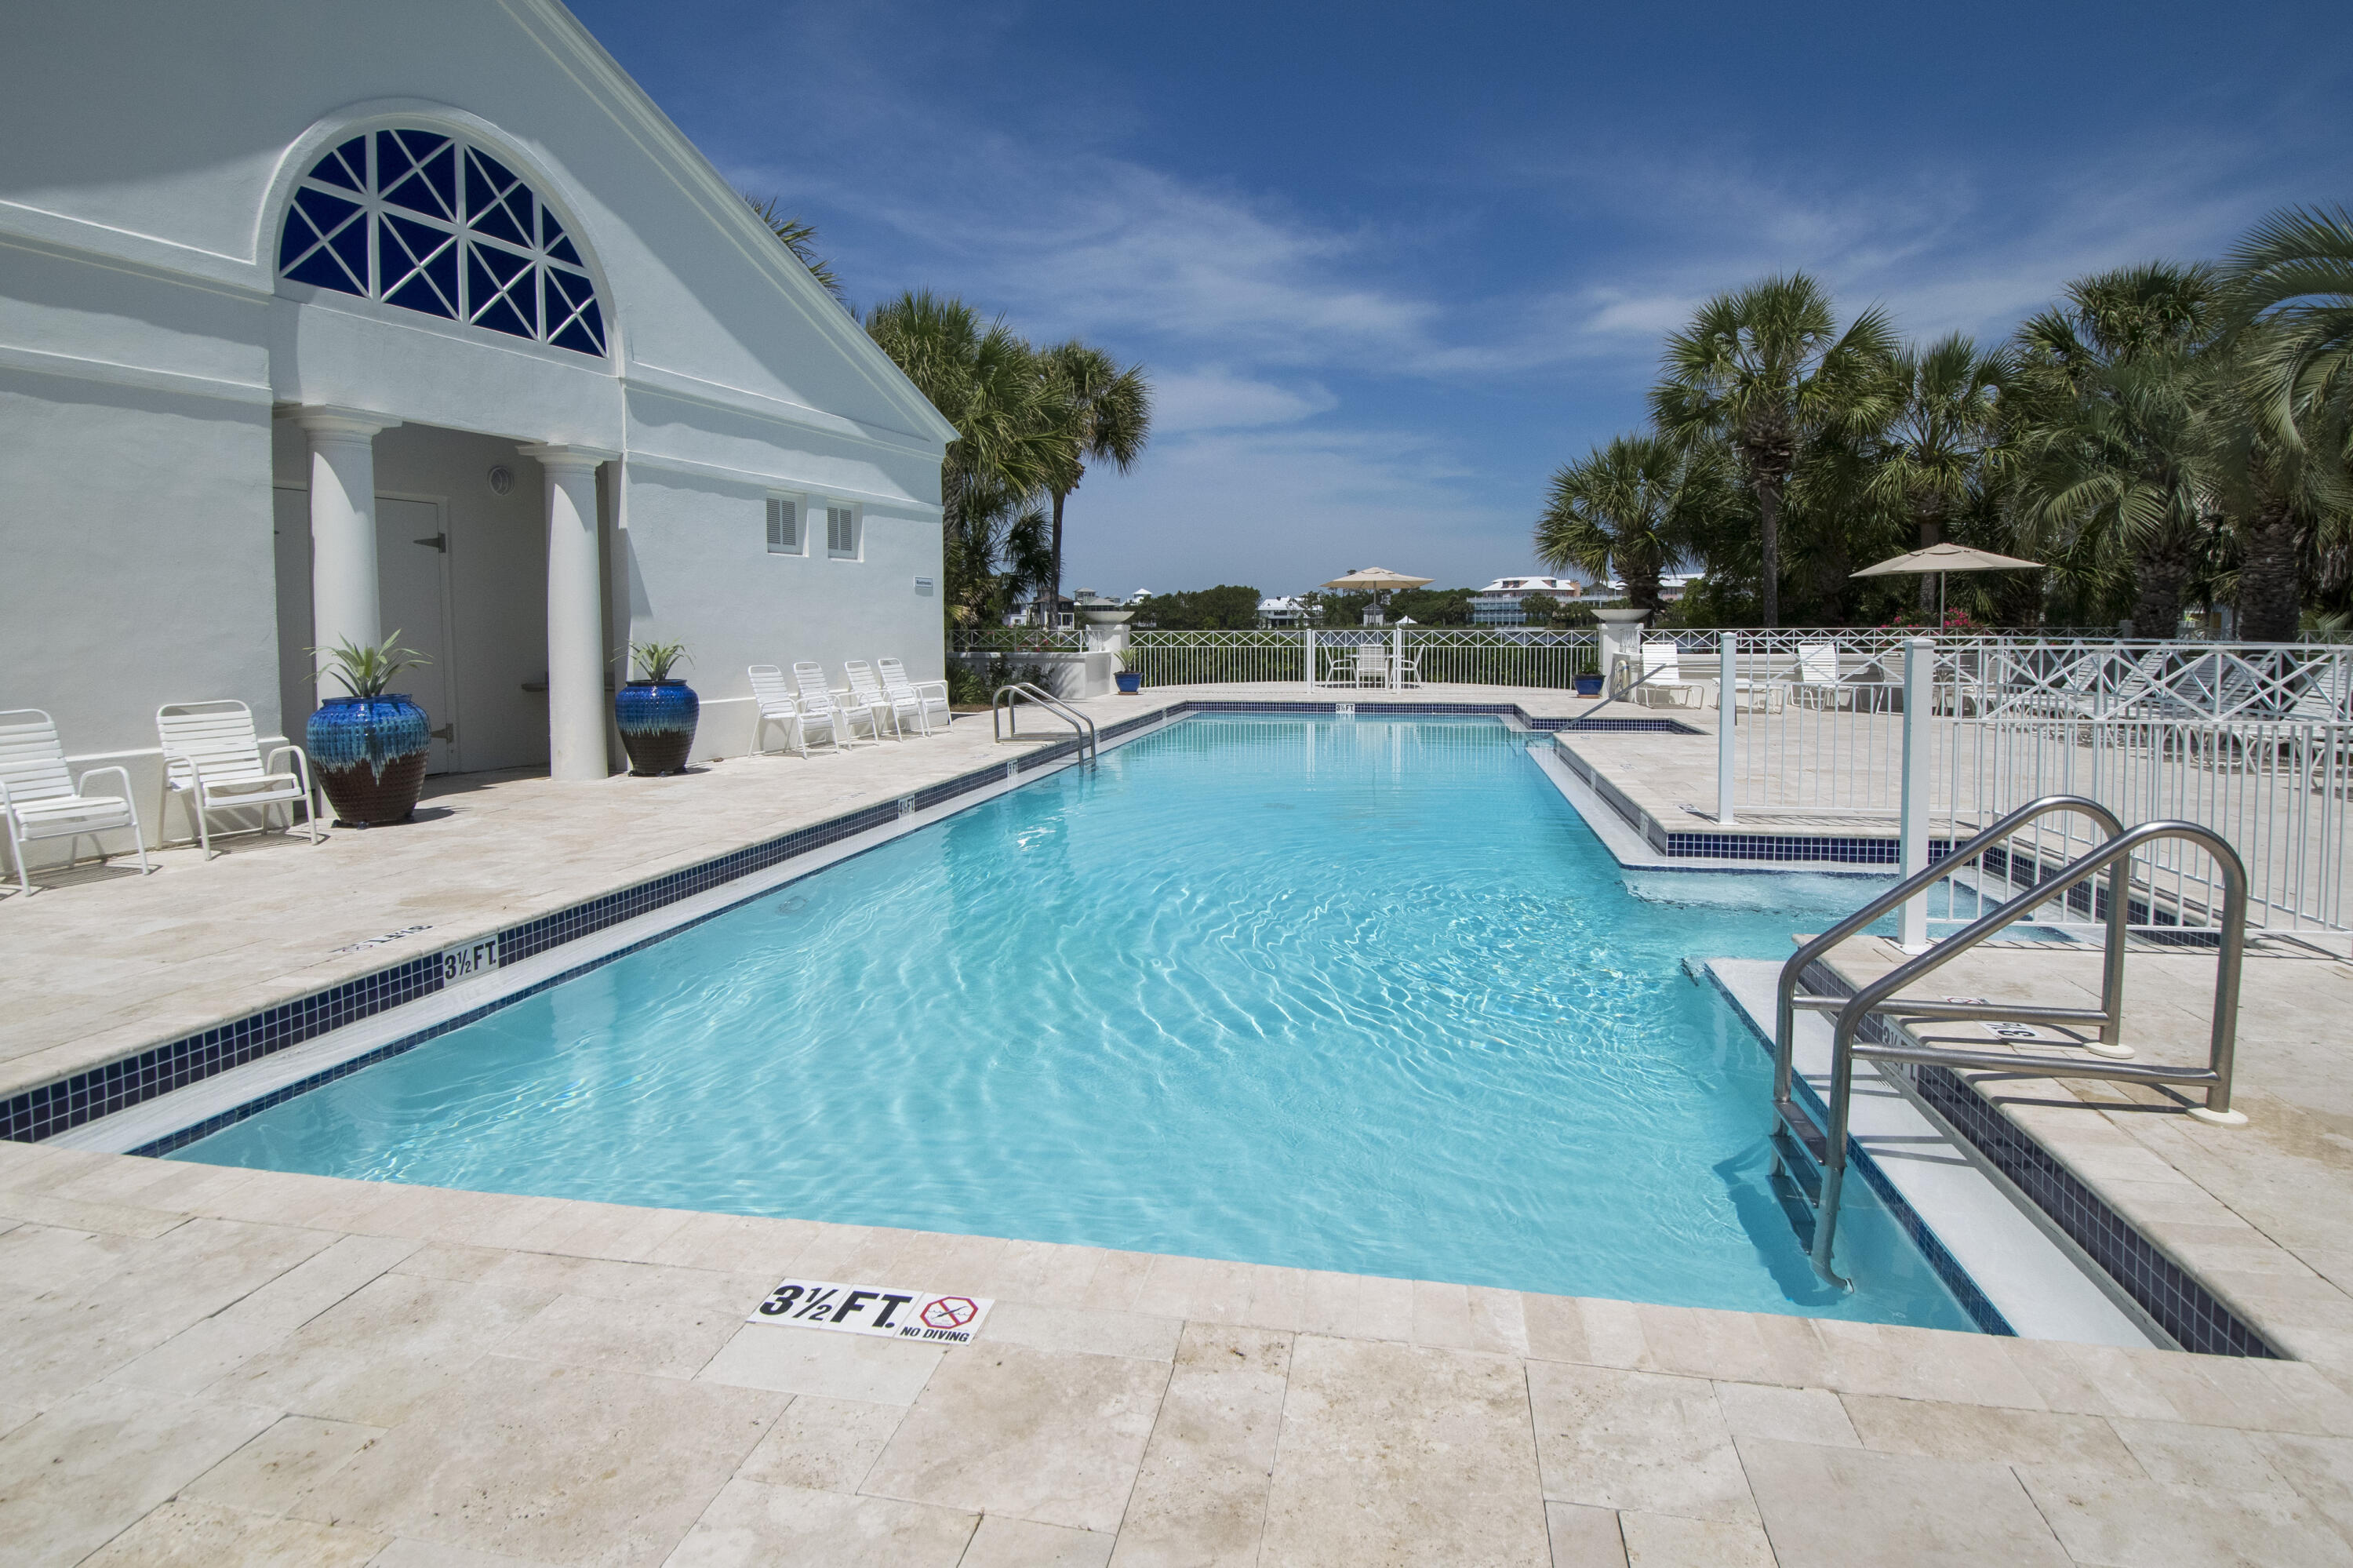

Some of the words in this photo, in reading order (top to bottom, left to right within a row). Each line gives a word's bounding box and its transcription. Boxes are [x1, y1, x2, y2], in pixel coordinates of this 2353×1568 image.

[474, 940, 496, 971] FT.
[829, 1290, 913, 1329] FT.
[899, 1326, 921, 1337] NO
[922, 1328, 970, 1342] DIVING
